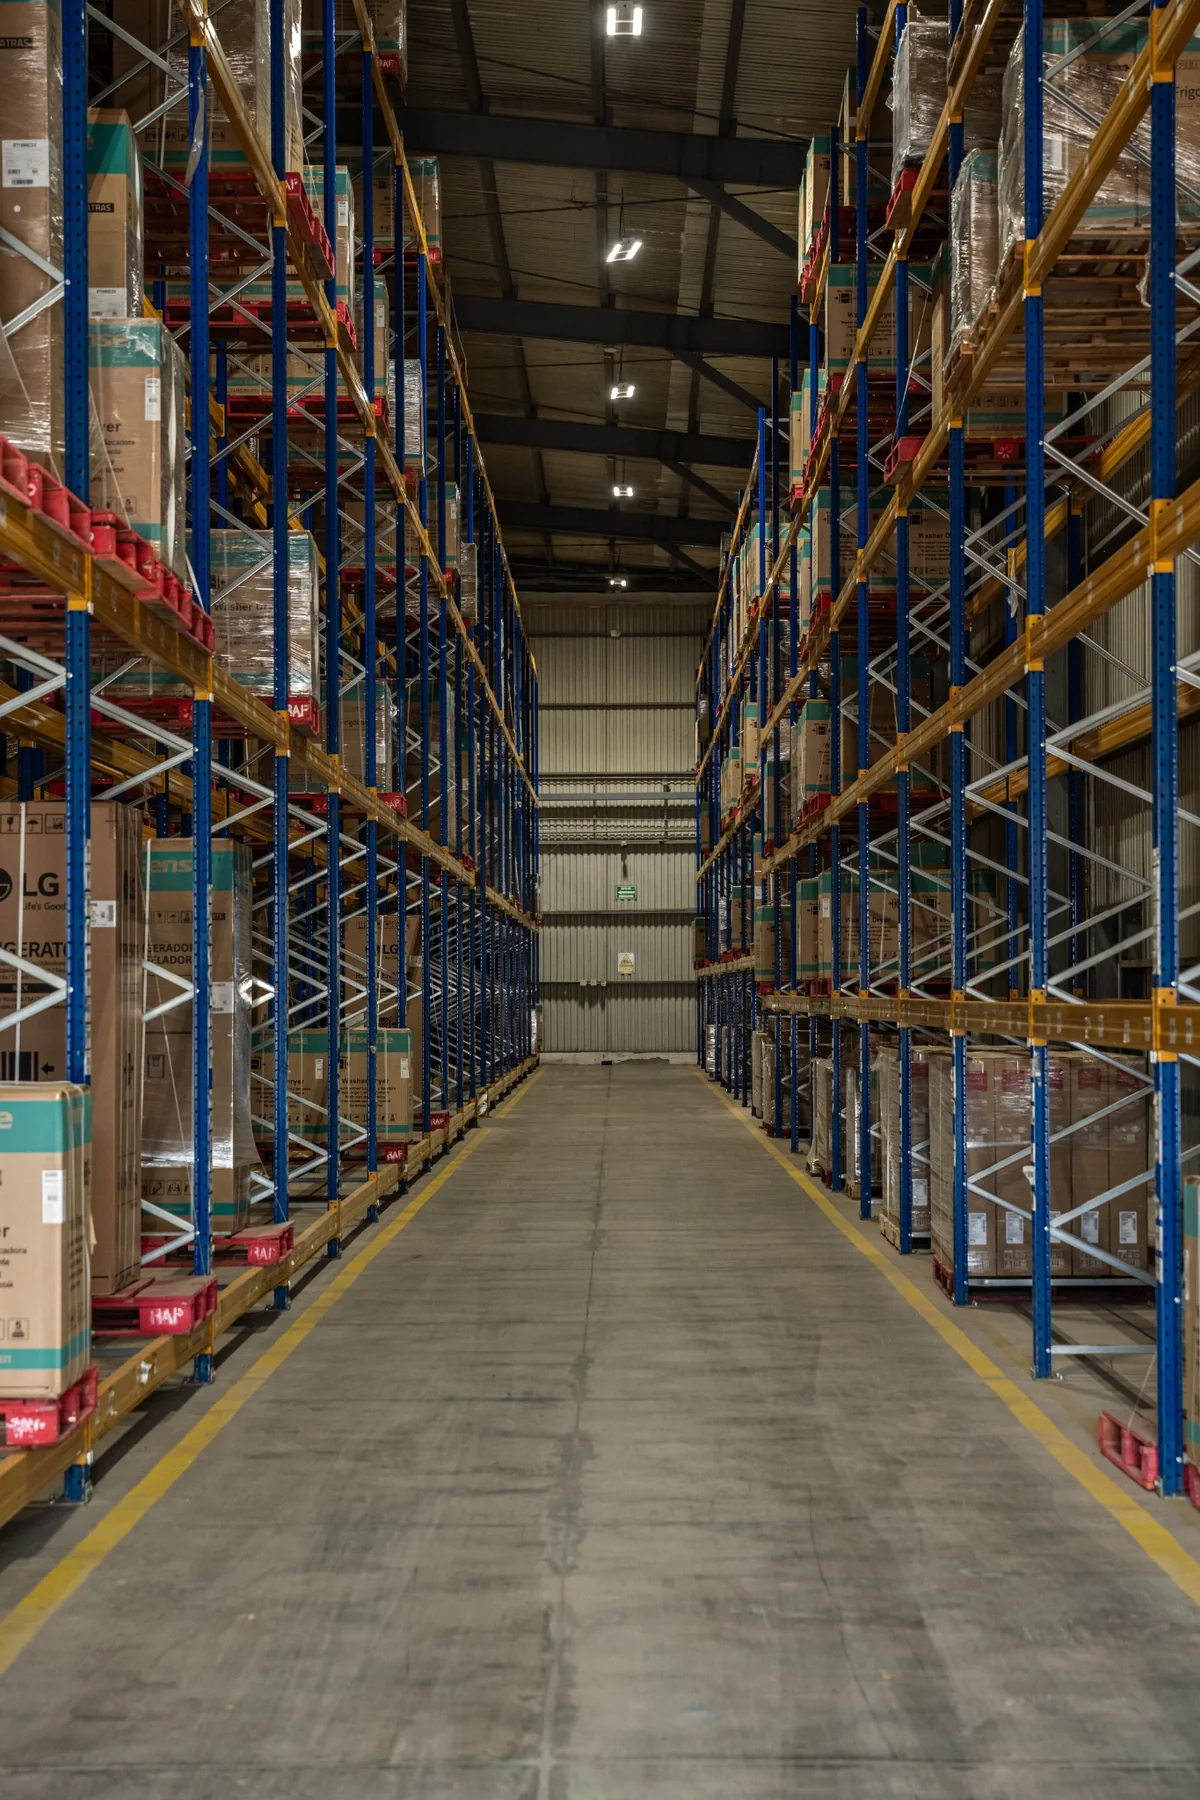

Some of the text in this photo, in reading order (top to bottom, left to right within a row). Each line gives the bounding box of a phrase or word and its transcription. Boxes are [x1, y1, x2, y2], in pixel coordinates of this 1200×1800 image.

[214, 602, 252, 612] Wsher
[23, 872, 60, 897] LG
[23, 902, 42, 911] ife's
[383, 945, 399, 955] LG
